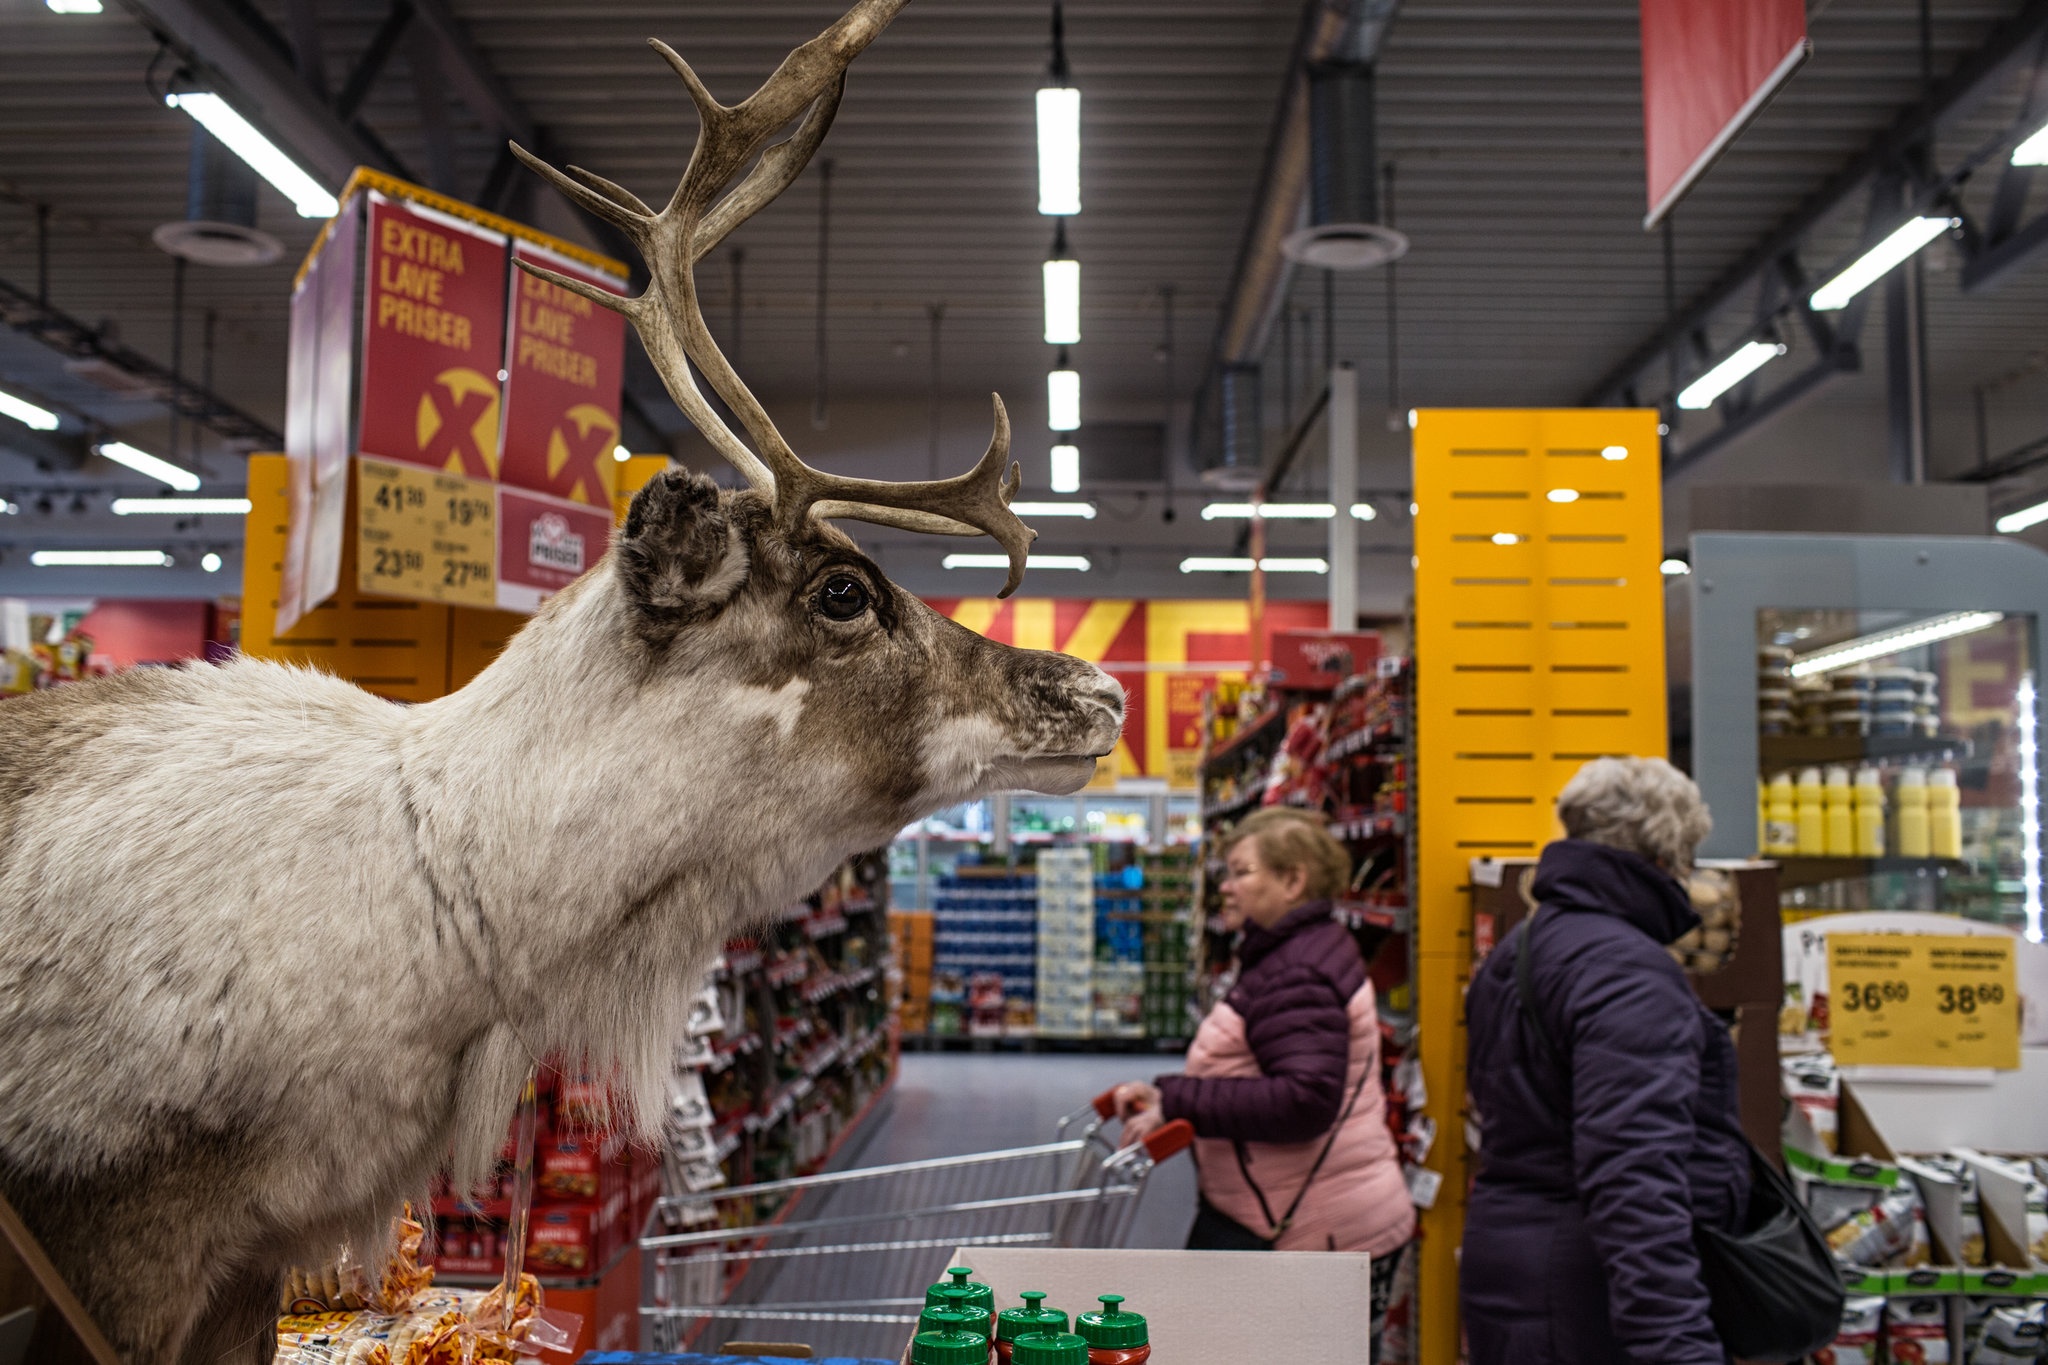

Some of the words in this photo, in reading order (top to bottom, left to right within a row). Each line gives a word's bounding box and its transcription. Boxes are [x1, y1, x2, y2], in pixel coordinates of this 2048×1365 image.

[382, 218, 464, 275] EXTRA
[380, 256, 443, 304] LAVE
[379, 294, 471, 351] PRISER
[521, 301, 574, 346] LAVE
[519, 335, 597, 387] PRISER
